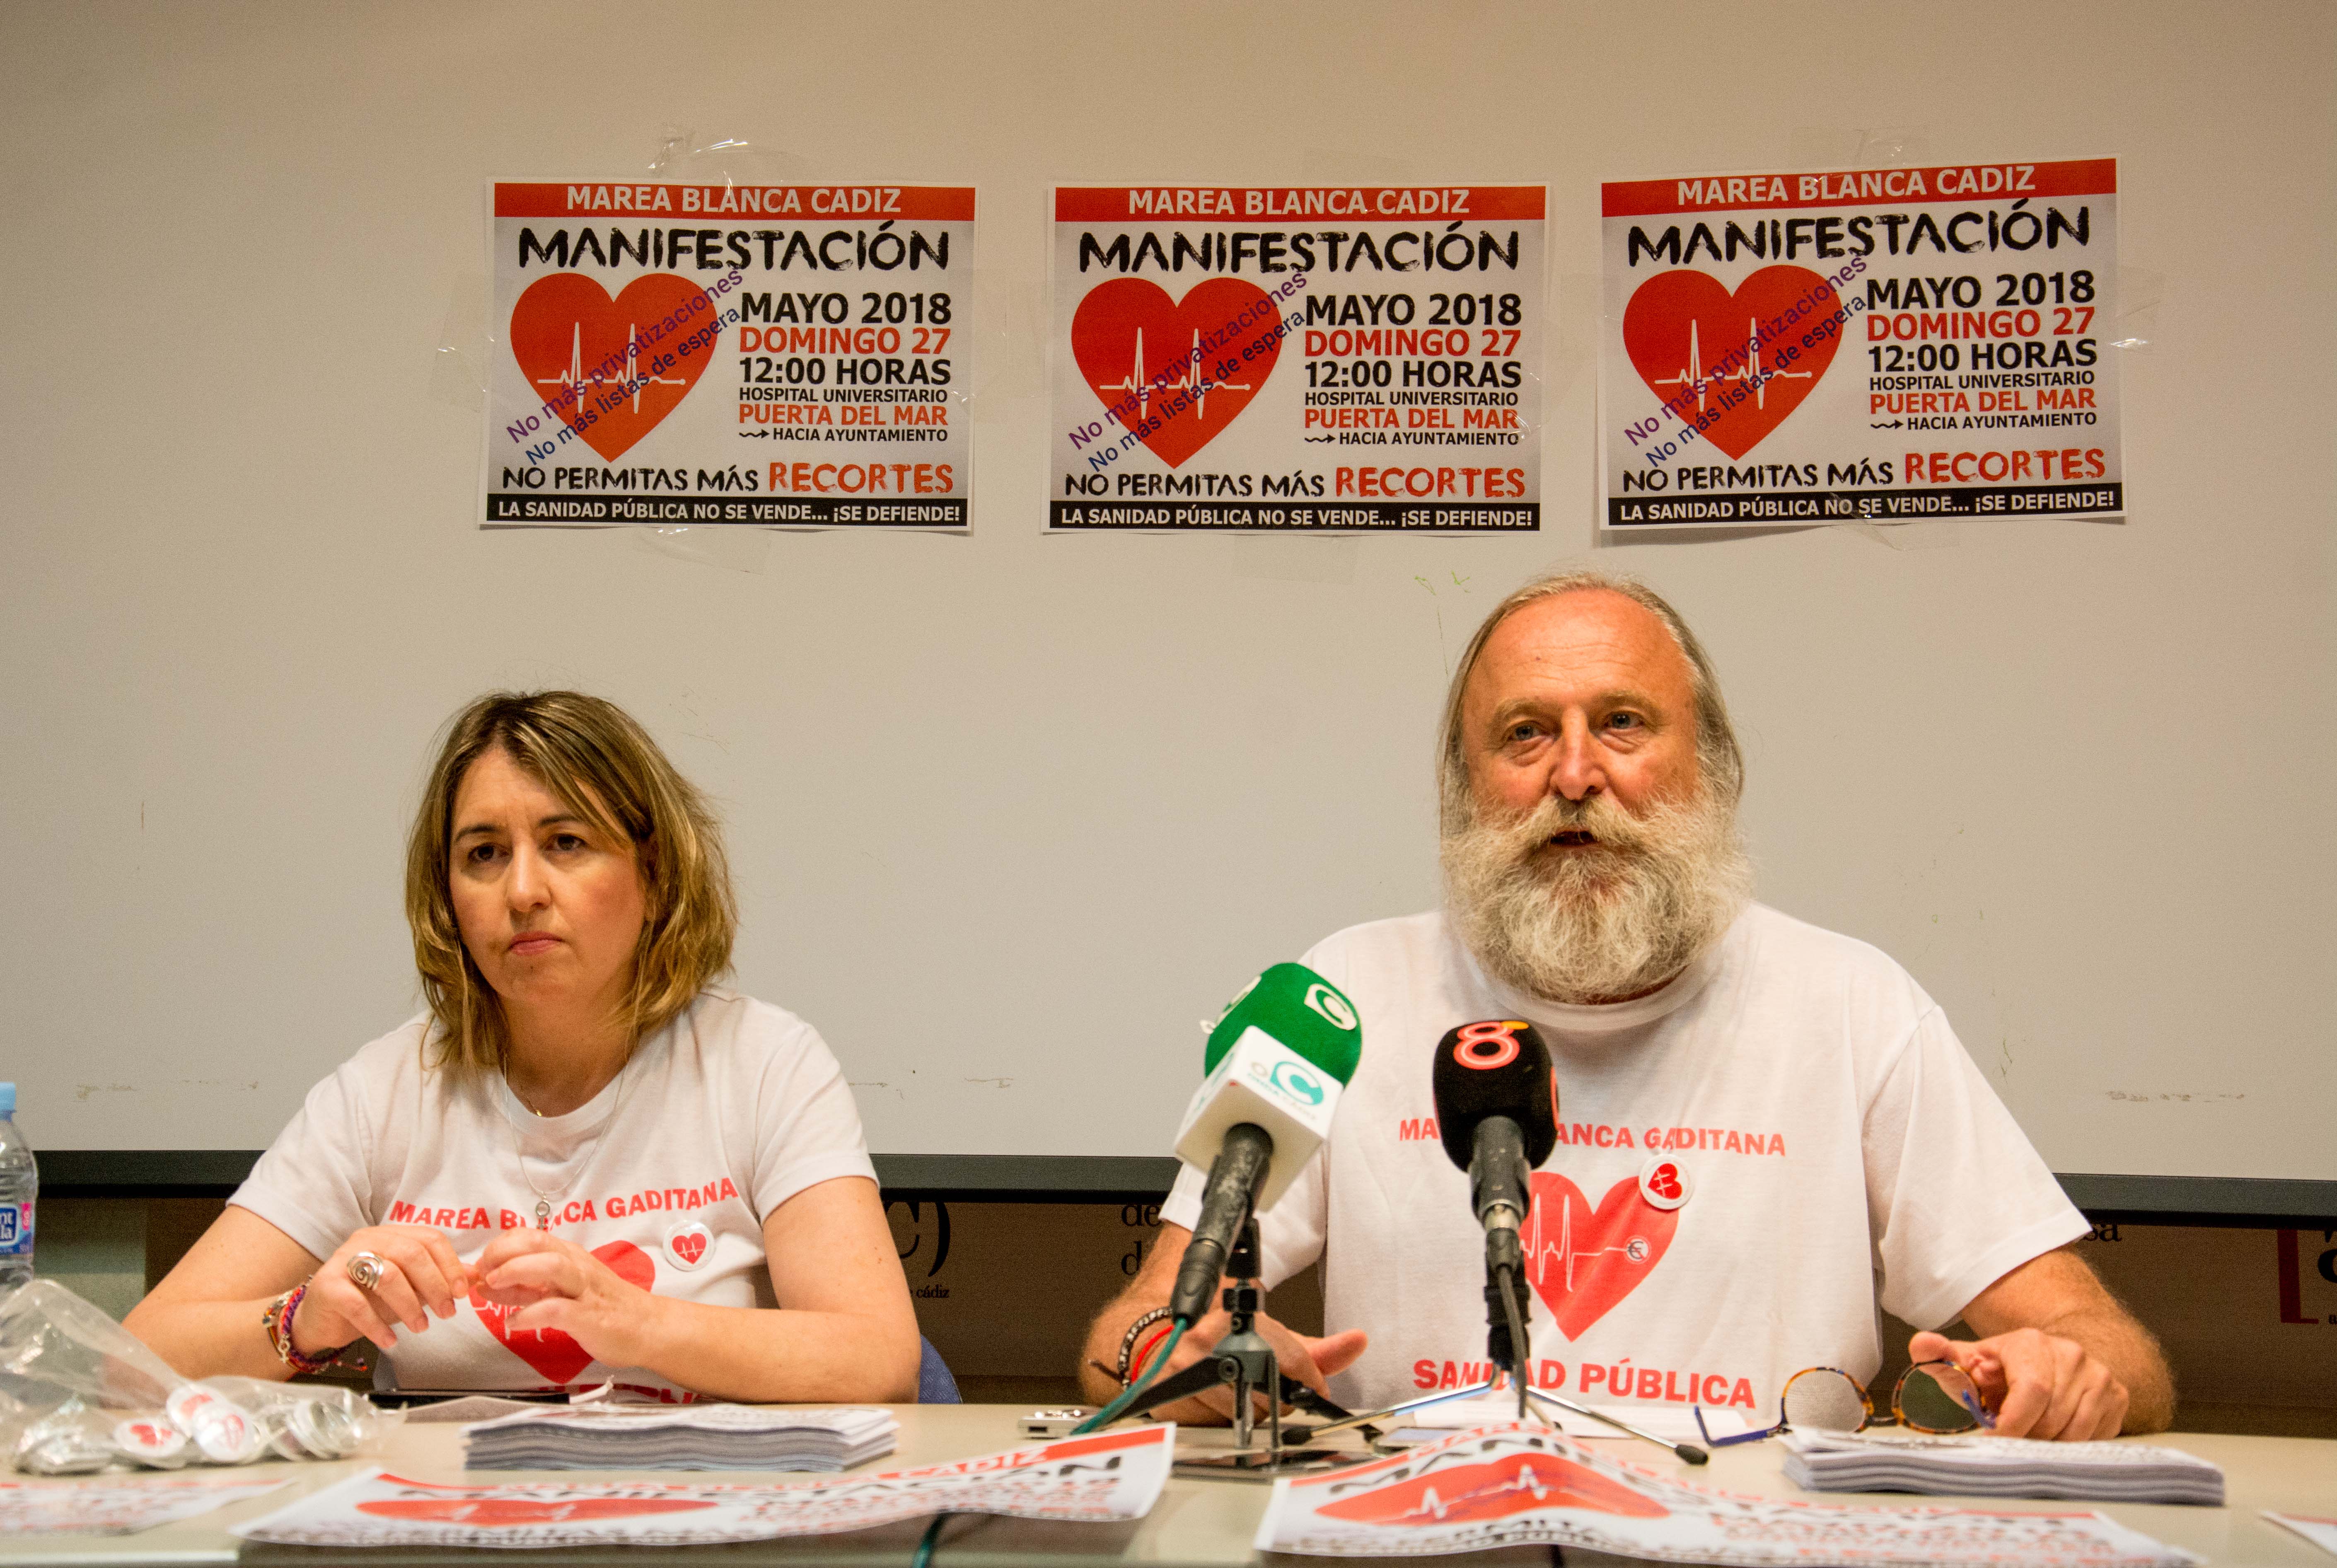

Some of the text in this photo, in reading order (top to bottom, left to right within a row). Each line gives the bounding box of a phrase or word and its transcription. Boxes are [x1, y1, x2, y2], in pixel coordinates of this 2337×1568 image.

[567, 185, 901, 214] MAREA BLANCA CADIZ
[1678, 165, 2035, 205] MAREA BLANCA CADIZ
[1130, 189, 1469, 215] MAREA BLANCA CADIZ
[519, 220, 949, 271] MANIFESTACIÓN
[1079, 220, 1519, 273] MANIFESTACIÓN
[1628, 197, 2089, 267] MANIFESTACIÓN
[1867, 270, 2095, 310] MAYO 2018
[741, 292, 951, 325] MAYO 2018
[1306, 293, 1522, 326] MAYO 2018
[1867, 306, 2095, 341] DOMINGO 27
[740, 326, 951, 355] DOMINGO 27
[1305, 329, 1521, 357] DOMINGO 27
[1624, 257, 1867, 446] No más privatizaciones
[1868, 338, 2097, 372] 12:00 HORAS
[506, 269, 742, 444] No más privatizaciones
[740, 357, 951, 386] 12:00 HORAS
[1068, 271, 1307, 450] No más privatizaciones
[525, 308, 741, 466] No más listas de espera
[1305, 360, 1521, 388] 12:00 HORAS
[1645, 296, 1867, 468] No más listas de espera
[1870, 370, 2095, 391] HOSPITAL UNIVERSITARIO
[740, 387, 947, 403] HOSPITAL UNIVERSITARIO
[1088, 310, 1307, 472] No más listas de espera
[1305, 391, 1518, 406] HOSPITAL UNIVERSITARIO
[1870, 388, 2097, 415] PUERTA DEL MAR
[739, 403, 948, 426] PUERTA DEL MAR
[1305, 408, 1519, 429] PUERTA DEL MAR
[1907, 412, 2097, 430] HACIA AYUNTAMIENTO
[773, 427, 947, 442] HACIA AYUNTAMIENTO
[1339, 432, 1519, 445] HACIA AYUNTAMIENTO
[503, 462, 953, 494] NO PERMITAS MÁS RECORTES
[1065, 467, 1525, 498] NO PERMITAS MÁS RECORTES
[1623, 448, 2105, 492] NO PERMITAS MÁS RECORTES
[499, 498, 959, 522] LA SANIDAD PÚBLICA NO SE VENDE... ¡SE DEFIENDE!
[1061, 504, 1532, 527] LA SANIDAD PÚBLICA NO SE VENDE... ¡SE DEFIENDE!
[1621, 491, 2114, 520] LA SANIDAD PÚBLICA NO SE VENDE... ¡SE DEFIENDE!
[1556, 1123, 1786, 1156] ANCA GADITANA
[389, 1201, 491, 1230] MAREA
[606, 1177, 739, 1219] GADITANA
[916, 1284, 950, 1298] cádiz
[1579, 1358, 1756, 1409] PÚBLICA
